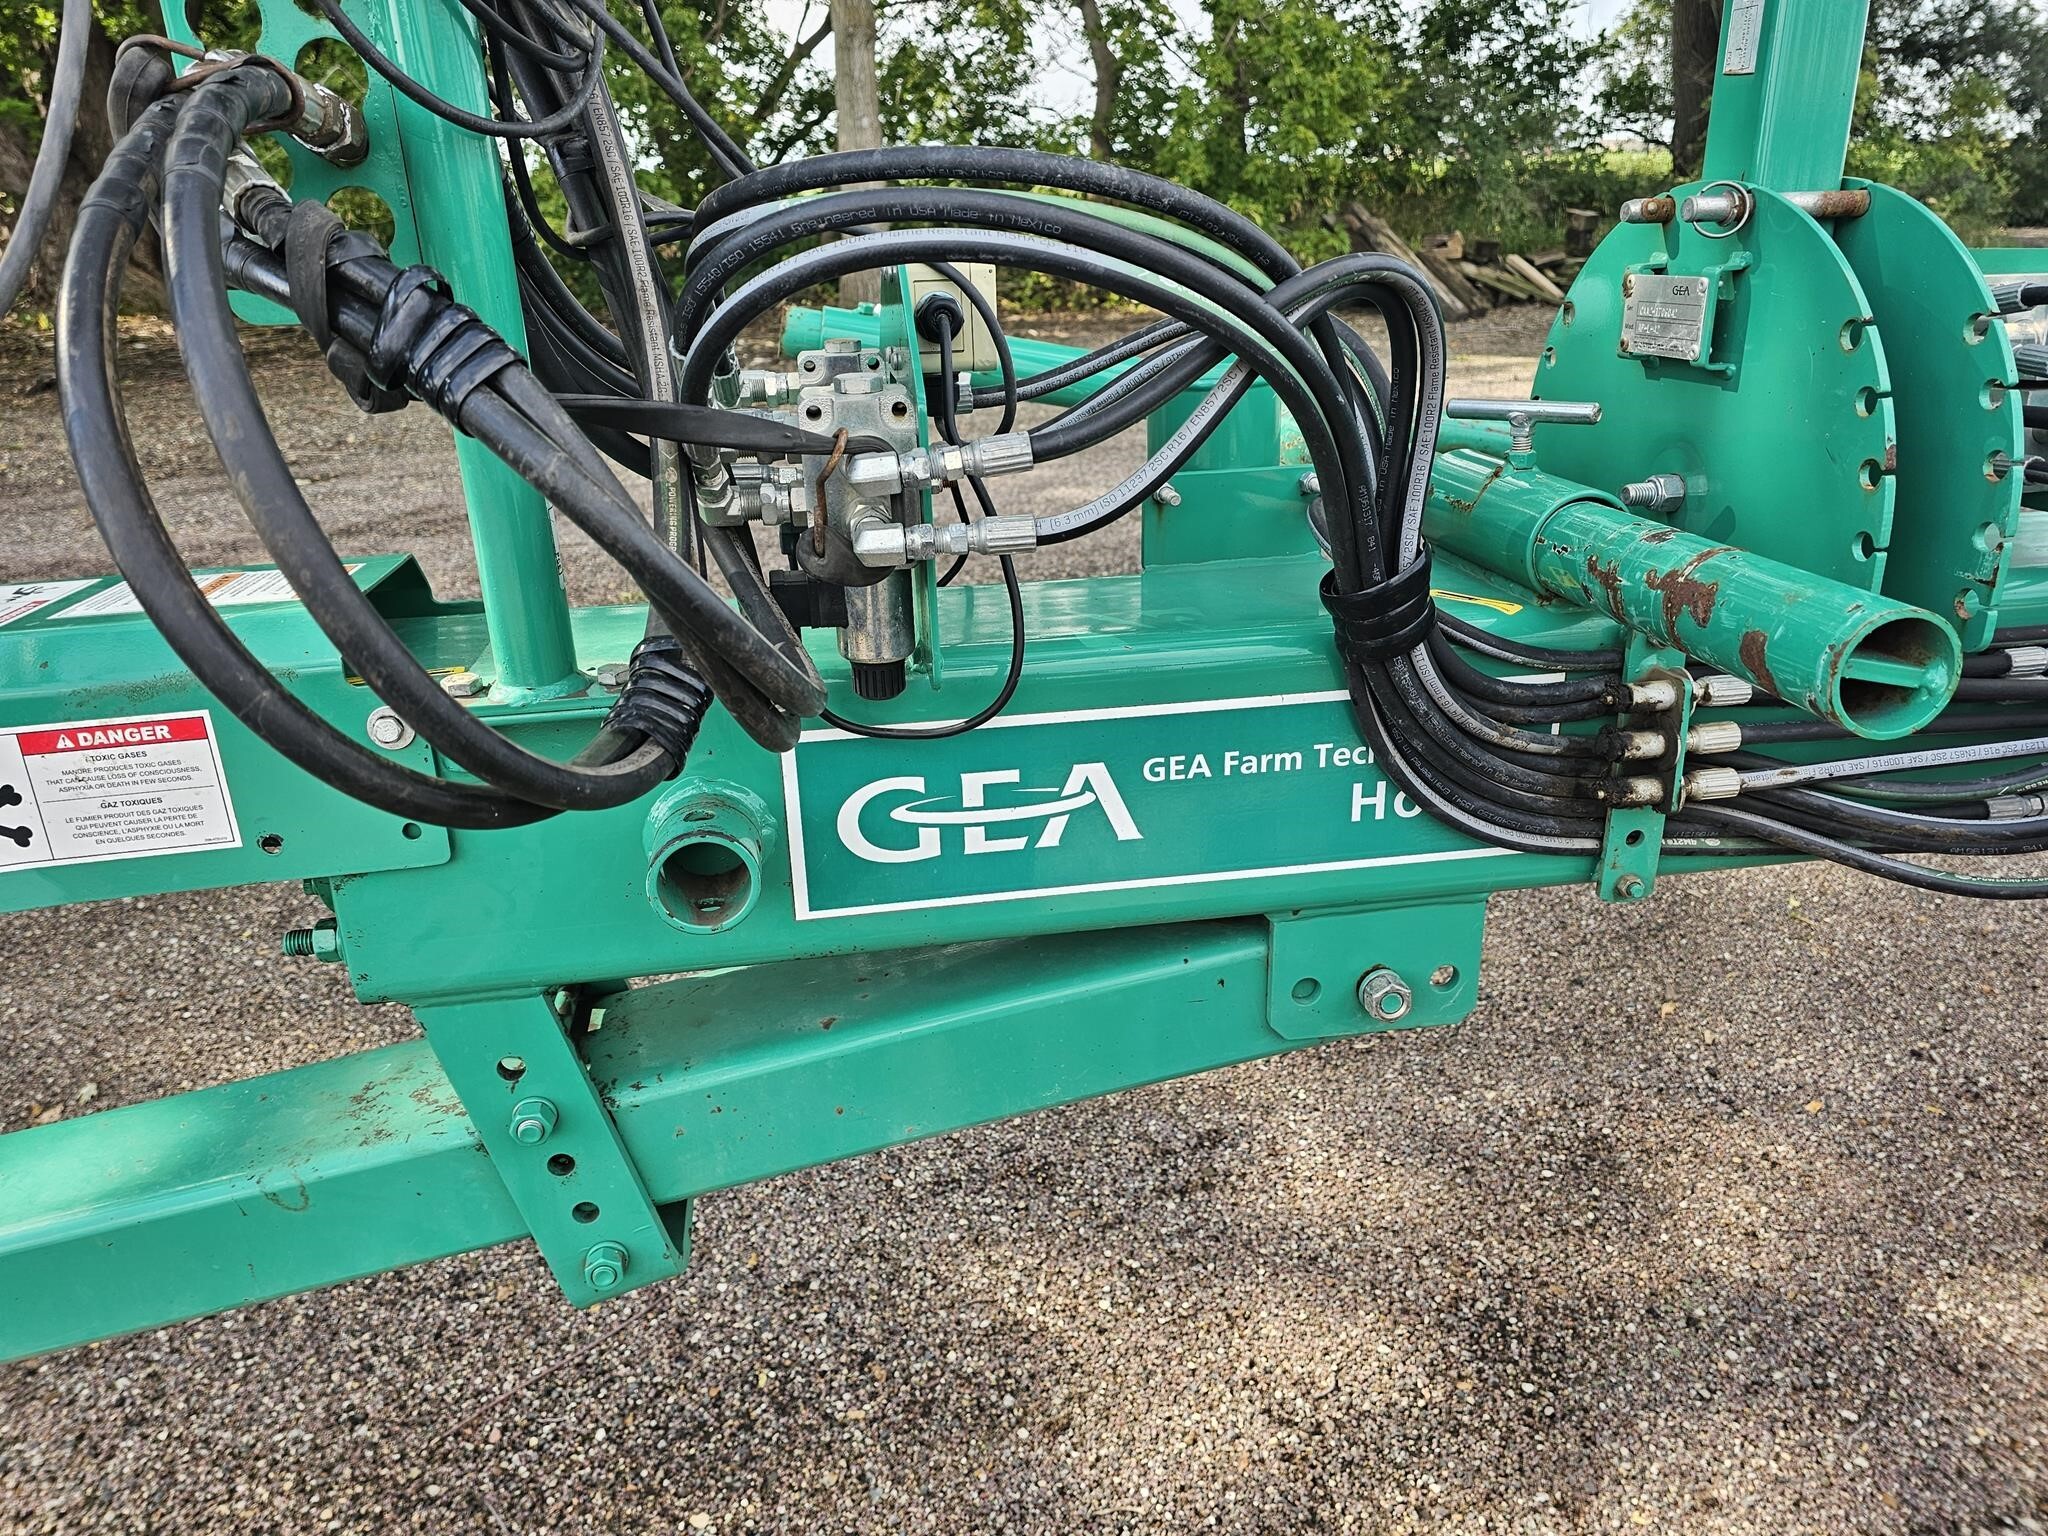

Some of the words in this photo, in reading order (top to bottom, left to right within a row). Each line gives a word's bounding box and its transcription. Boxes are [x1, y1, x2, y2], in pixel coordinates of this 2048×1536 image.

[592, 107, 611, 139] EN857
[610, 166, 622, 185] SAE
[616, 183, 634, 222] 100R16
[1010, 214, 1063, 235] Mexico
[627, 229, 640, 247] SAE
[632, 249, 648, 280] 100R2
[1672, 285, 1690, 296] GEA
[1429, 329, 1441, 370] Resistant
[1428, 371, 1440, 401] Flame
[1423, 402, 1437, 433] 100R2
[1100, 492, 1118, 511] ISO
[1119, 469, 1150, 498] 11237
[1148, 452, 1169, 472] 2SC
[1167, 430, 1187, 454] R16
[1190, 392, 1219, 427] EN857
[1218, 370, 1239, 393] 2SC
[1420, 434, 1433, 456] SAE
[1411, 465, 1427, 503] 100R16
[1407, 504, 1420, 525] SAE
[1404, 533, 1415, 552] 2SC
[77, 725, 172, 747] DANGER
[90, 753, 116, 762] TOXIC
[118, 751, 148, 760] GASES
[1908, 755, 1925, 765] SAE
[1930, 752, 1948, 762] 2SC
[1949, 749, 1977, 760] EN857
[1984, 746, 2001, 756] R16
[94, 764, 134, 773] PRODUCES
[135, 761, 156, 769] TOXIC
[157, 759, 182, 767] GASES
[1142, 753, 1214, 783] GEA
[1223, 745, 1303, 776] Farm
[1818, 763, 1848, 776] 100R2
[1848, 762, 1865, 772] SAE
[1873, 758, 1907, 769] 100R16
[46, 778, 64, 786] THAT
[107, 772, 127, 781] LOSS
[58, 783, 94, 793] ASPHYXIA
[106, 780, 131, 789] DEATH
[132, 779, 139, 787] IN
[140, 778, 157, 786] FEW
[100, 801, 119, 809] GAZ
[121, 797, 163, 808] TOXIQUES
[836, 761, 1144, 864] GEA
[75, 814, 102, 823] FUMIER
[104, 811, 135, 820] PRODUIT
[152, 808, 167, 816] GAZ
[168, 804, 204, 814] TOXIQUES
[75, 823, 89, 831] QUI
[90, 820, 122, 830] PEUVENT
[123, 818, 152, 827] CAUSER
[164, 814, 187, 822] PERTE
[187, 812, 198, 820] DE
[175, 821, 184, 829] LA
[184, 820, 204, 828] MORT
[95, 837, 106, 845] EN
[106, 834, 145, 844] QUELQUES
